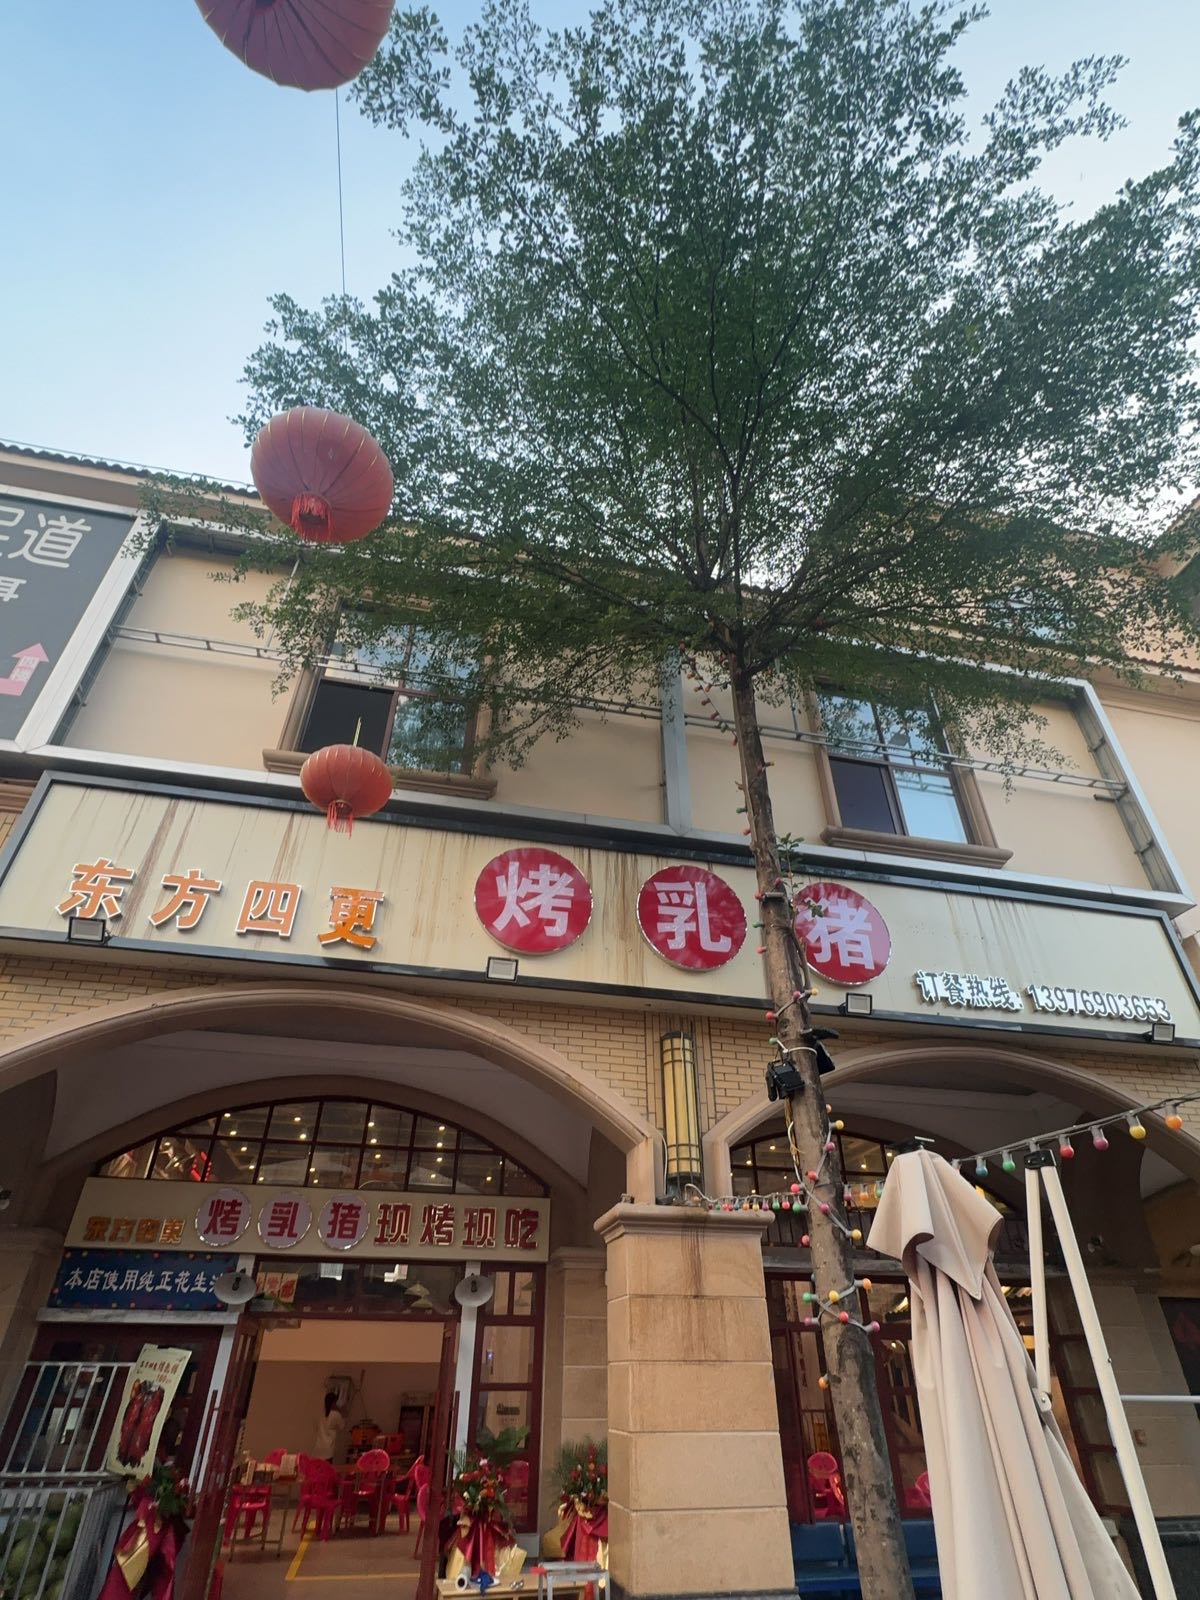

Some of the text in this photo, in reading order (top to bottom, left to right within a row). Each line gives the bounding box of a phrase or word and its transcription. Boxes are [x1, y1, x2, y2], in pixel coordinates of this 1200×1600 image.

[56, 858, 878, 972] 东方四更 烤乳猪
[1028, 985, 1172, 1022] 13976903653
[204, 1199, 362, 1238] 烤乳猪
[374, 1203, 539, 1249] 现烤现吃
